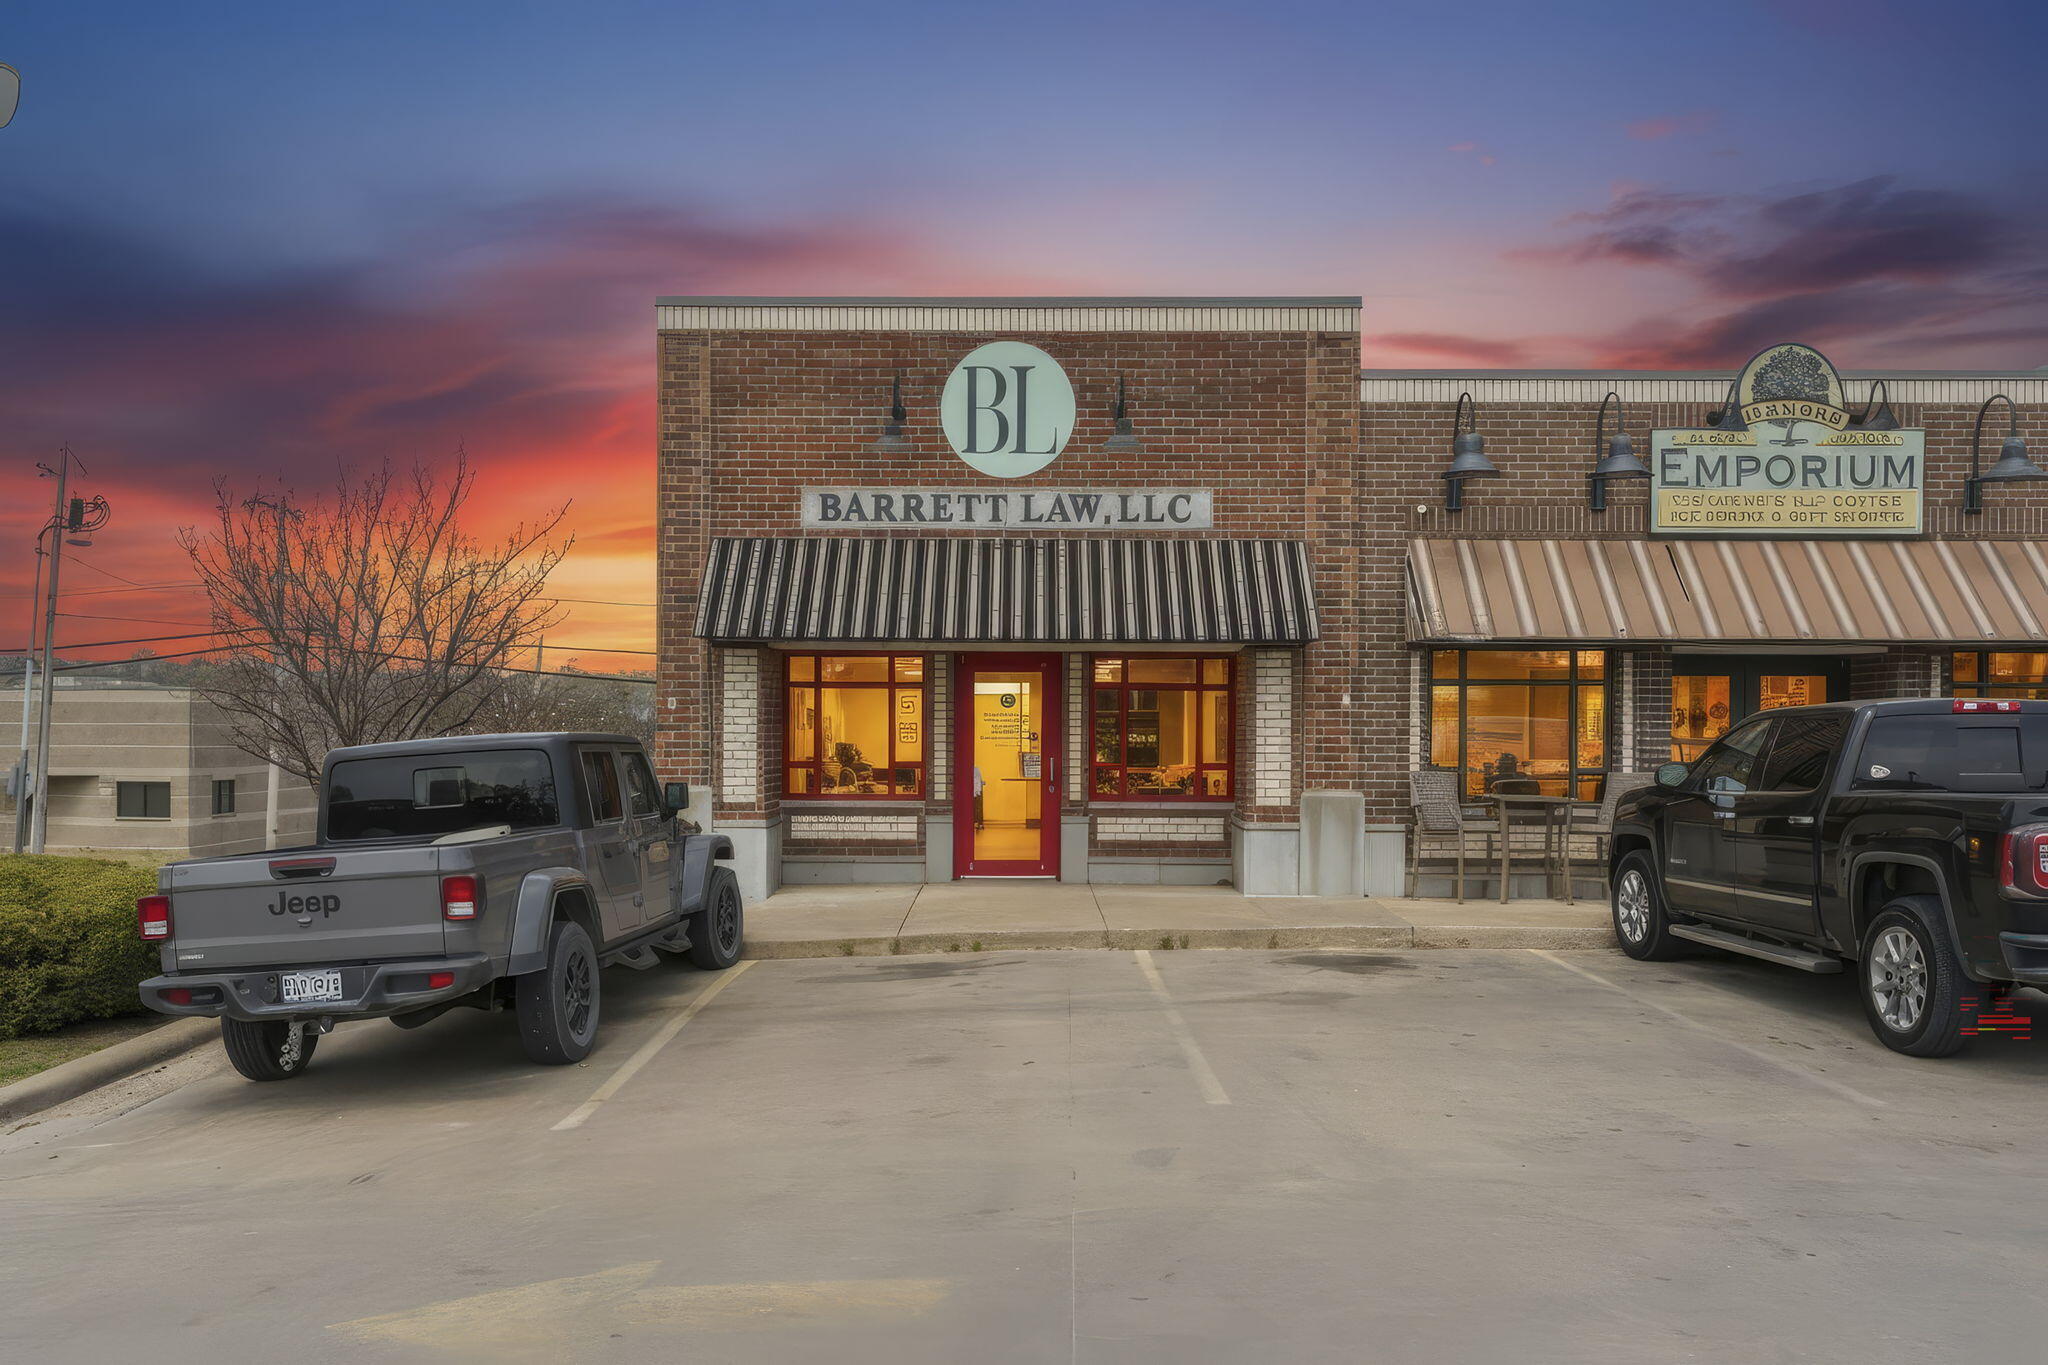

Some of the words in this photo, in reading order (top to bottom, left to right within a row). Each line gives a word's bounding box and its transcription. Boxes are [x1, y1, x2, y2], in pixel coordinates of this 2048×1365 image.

[961, 365, 1058, 455] BL
[1660, 448, 1915, 488] EMPORIUM
[818, 493, 1008, 523] BARRETT
[268, 891, 341, 918] Jeep
